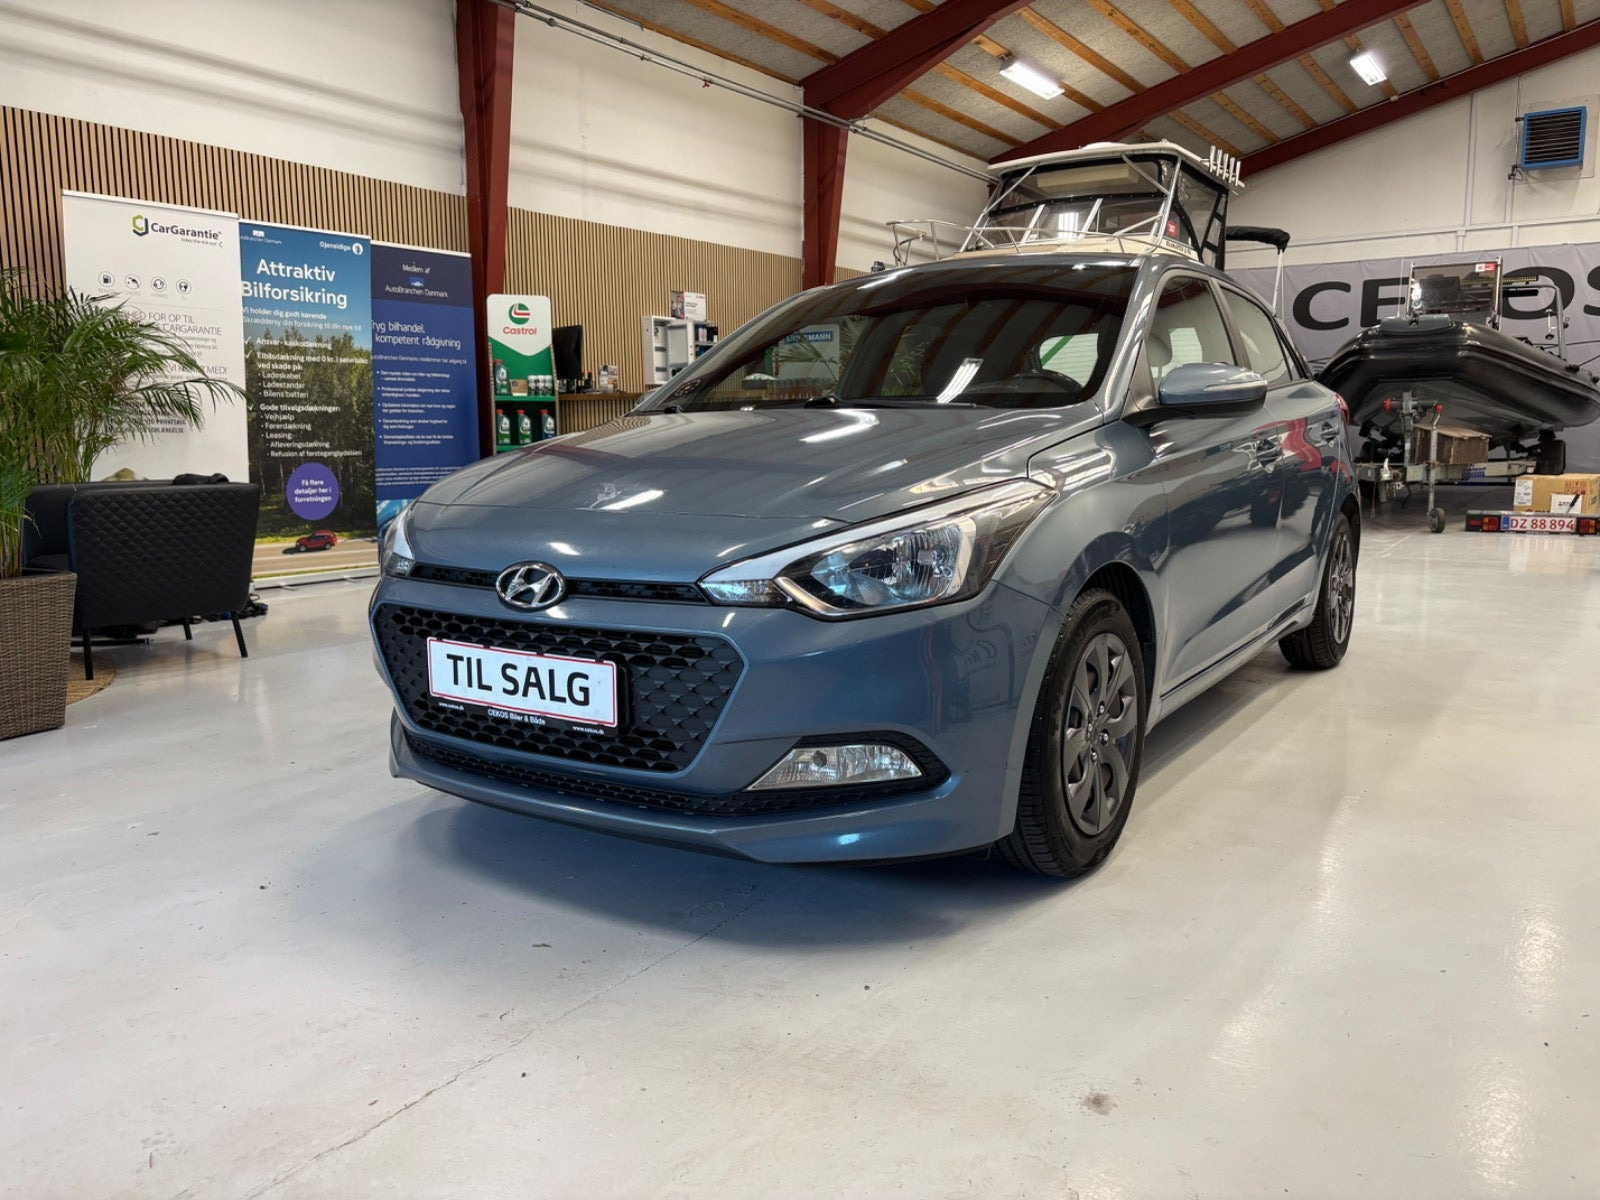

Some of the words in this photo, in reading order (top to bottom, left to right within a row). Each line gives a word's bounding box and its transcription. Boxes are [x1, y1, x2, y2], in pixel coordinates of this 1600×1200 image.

[150, 222, 219, 240] CarGarantie
[257, 258, 336, 282] Attraktiv
[241, 281, 347, 309] Bilforsikring
[425, 288, 448, 297] Danmark
[502, 326, 538, 335] Castrol
[375, 334, 420, 346] kompetent
[422, 335, 461, 351] rådgivning
[1510, 519, 1527, 529] DZ
[1531, 519, 1546, 529] 88
[1550, 519, 1575, 530] 894
[446, 653, 493, 692] TIL
[501, 662, 590, 707] SALG
[487, 708, 509, 719] CEKOS
